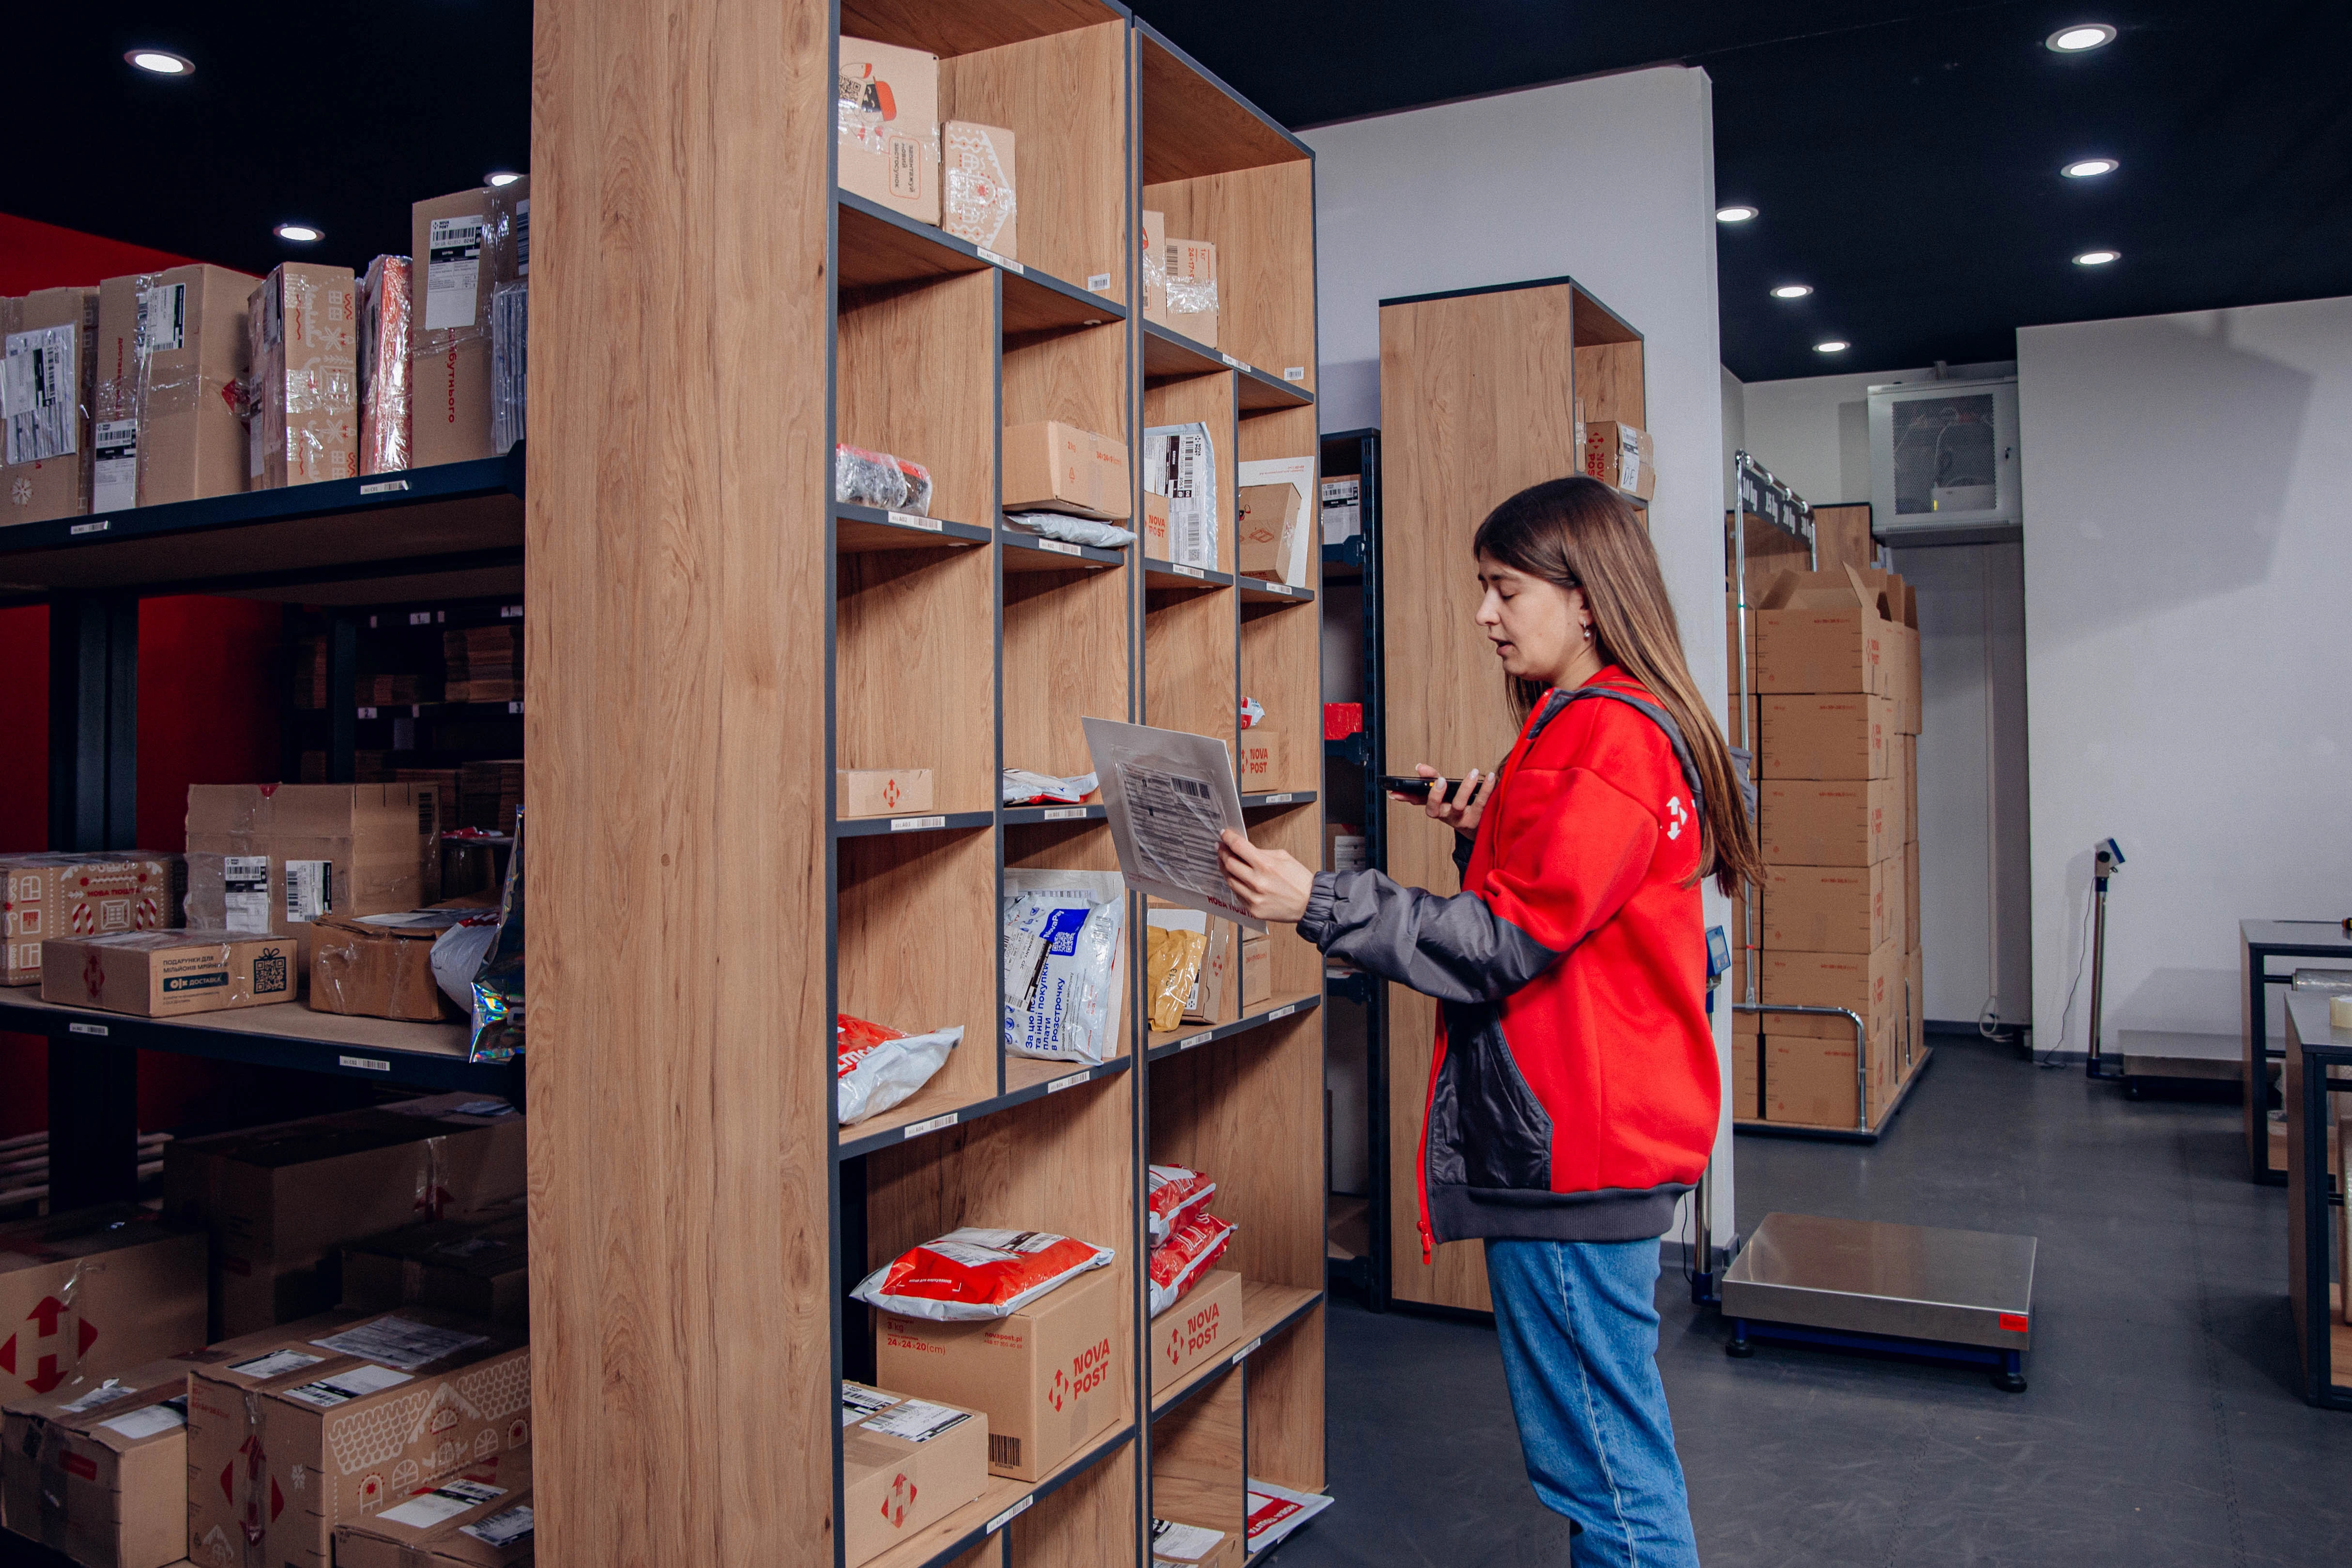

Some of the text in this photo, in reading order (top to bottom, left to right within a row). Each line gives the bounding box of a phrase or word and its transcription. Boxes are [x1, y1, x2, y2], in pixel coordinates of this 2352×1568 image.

[1588, 453, 1596, 476] POS
[1149, 515, 1166, 528] NOVA
[1149, 525, 1165, 538] POST
[1250, 748, 1268, 760] NOVA
[1250, 762, 1268, 774] POST
[111, 887, 140, 895] ПОШТА
[1207, 896, 1230, 910] НОВА
[1042, 909, 1065, 938] NovaPay
[189, 976, 222, 986] ДОСТАВКА
[1035, 961, 1050, 1050] та інші покупки
[1053, 978, 1066, 1041] розстрочку
[1028, 1014, 1035, 1032] цю
[1043, 1017, 1051, 1050] плати
[1025, 1035, 1034, 1049] За
[1188, 1302, 1220, 1335] NOVA
[894, 1322, 904, 1332] kg
[984, 1332, 1023, 1342] novapost.pl
[1188, 1323, 1219, 1355] POST
[1073, 1338, 1110, 1375] NOVA
[1073, 1361, 1109, 1400] POST
